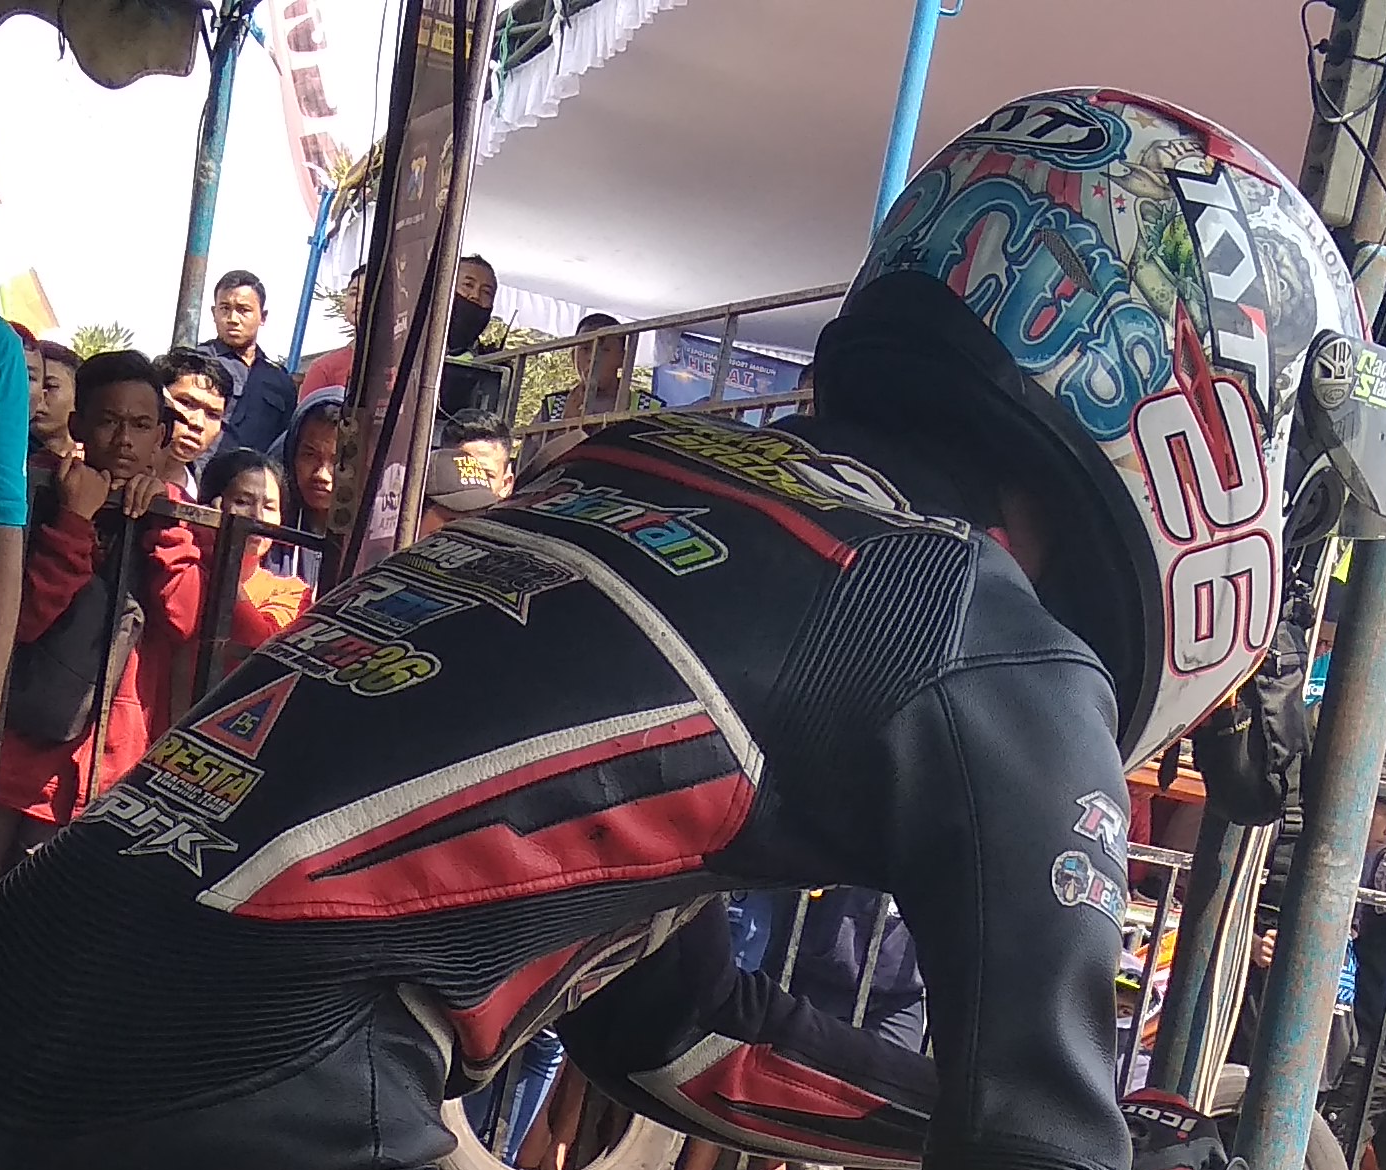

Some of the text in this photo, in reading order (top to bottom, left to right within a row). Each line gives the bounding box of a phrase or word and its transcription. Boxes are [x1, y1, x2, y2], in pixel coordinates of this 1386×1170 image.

[687, 355, 755, 386] HEAT
[1131, 375, 1281, 676] 26
[144, 736, 255, 805] RESTA
